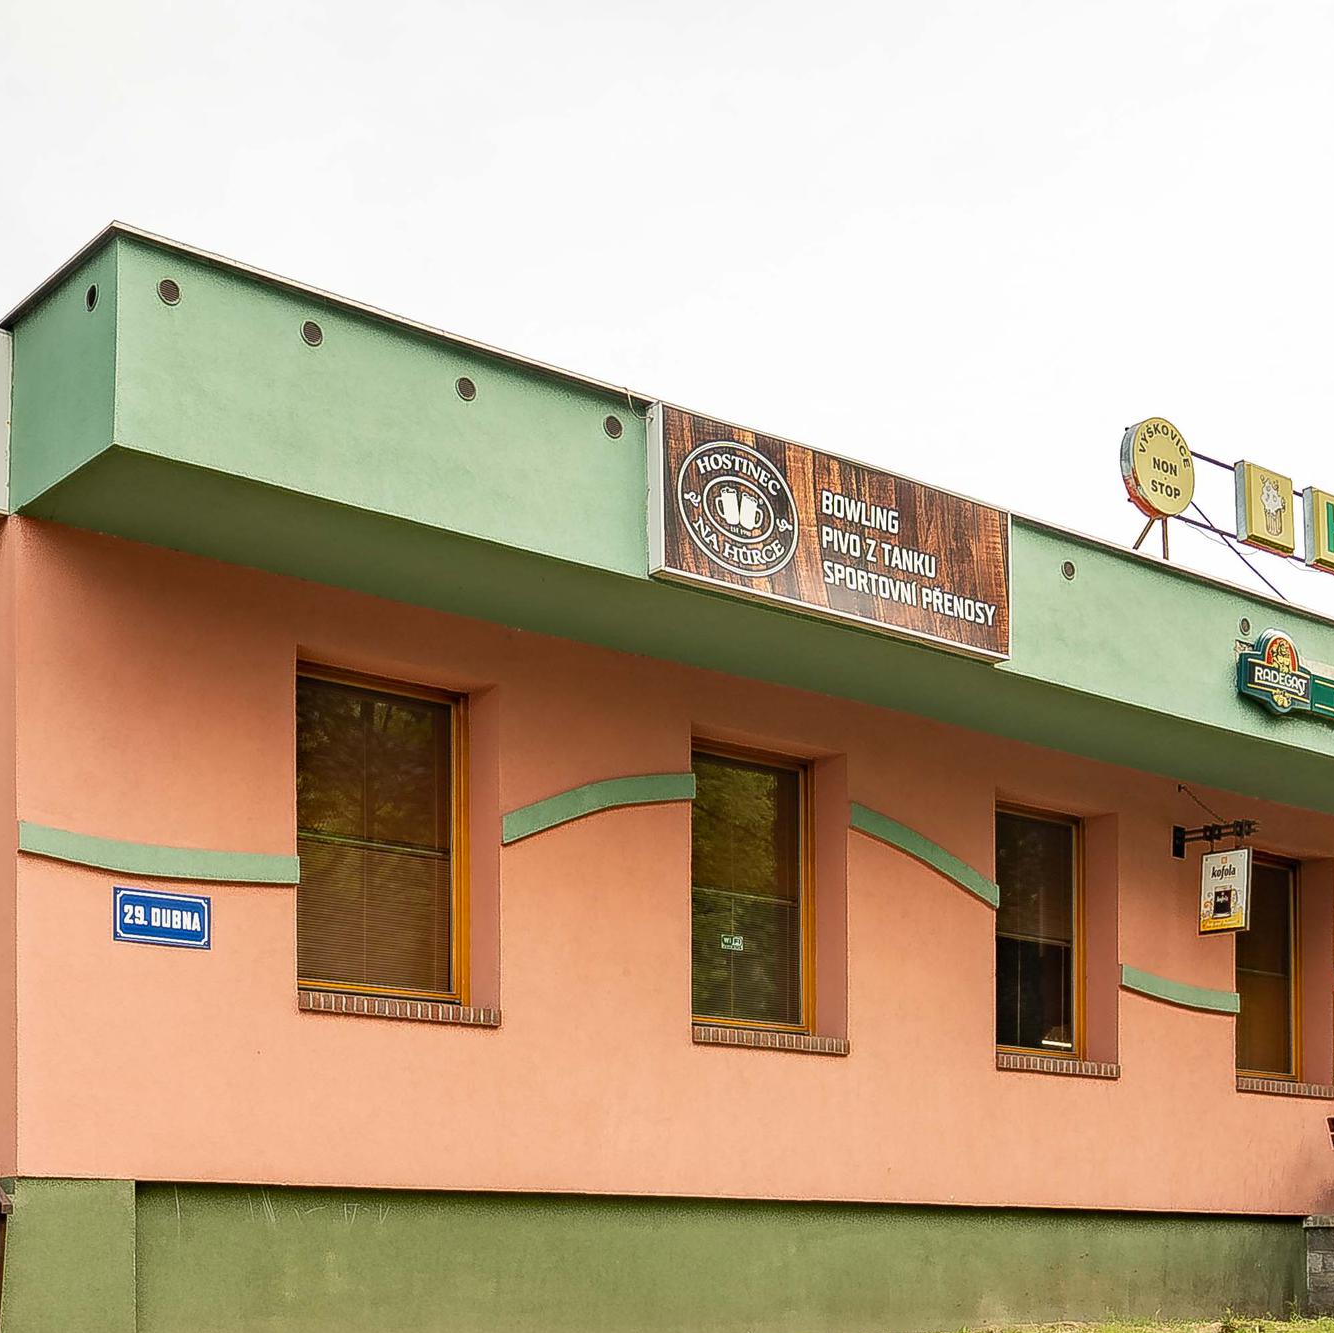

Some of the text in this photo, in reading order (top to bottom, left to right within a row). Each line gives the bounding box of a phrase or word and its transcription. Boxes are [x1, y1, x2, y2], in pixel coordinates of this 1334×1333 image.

[1138, 423, 1191, 468] VÝŠKOVICE
[1153, 457, 1177, 476] NON
[697, 453, 781, 496] HOSTINEC
[1151, 480, 1180, 499] STOP
[821, 490, 899, 534] BOWLING
[692, 516, 785, 565] NA HŮRCE
[821, 525, 936, 578] PIVO Z TANKU
[823, 560, 997, 627] SPORTOVNÍ PŘENOSY
[1254, 665, 1308, 697] RADEGAST
[1211, 864, 1236, 880] kofola
[123, 904, 201, 931] 29. DUBNA
